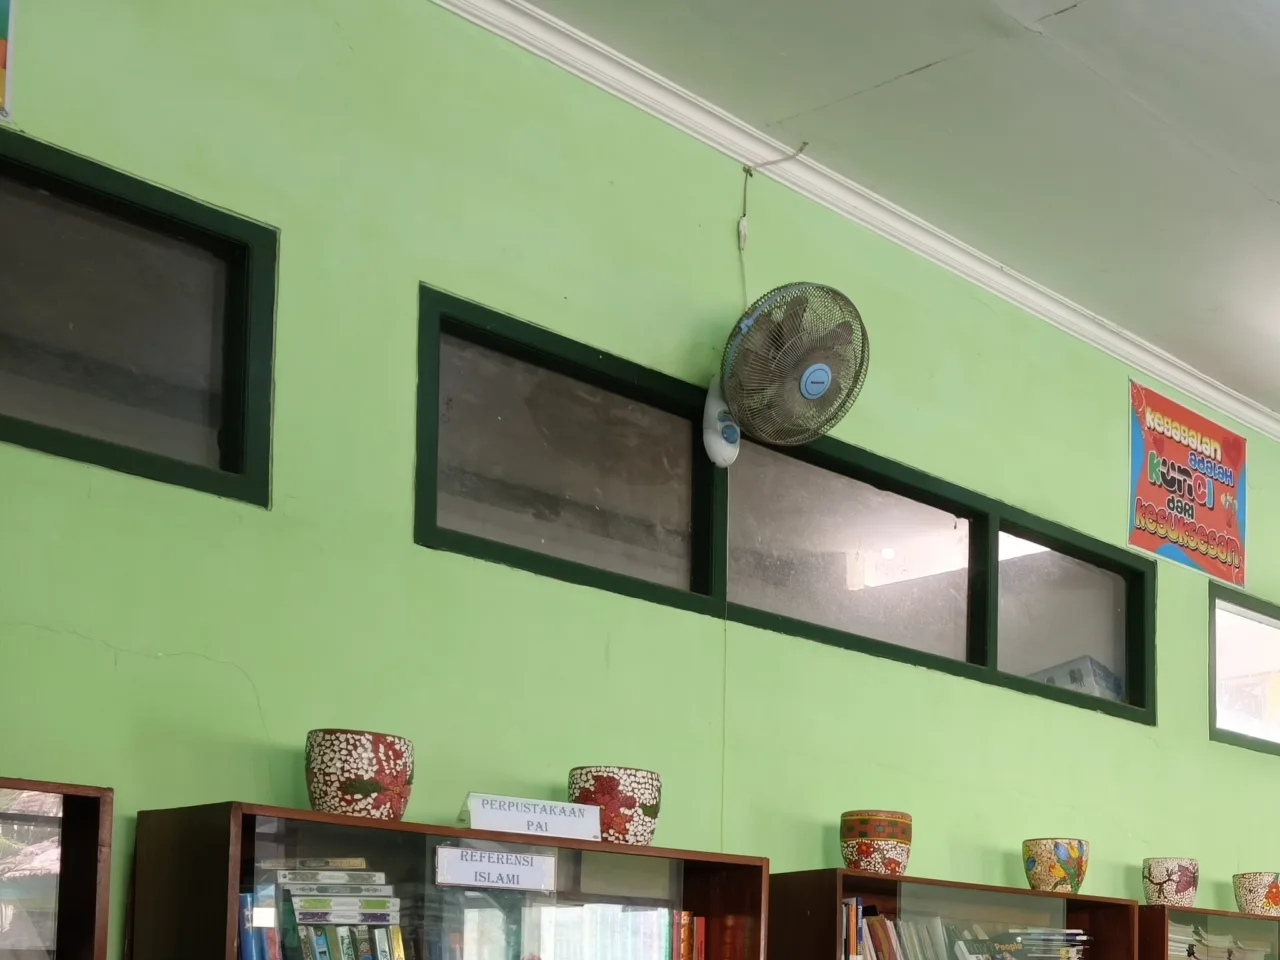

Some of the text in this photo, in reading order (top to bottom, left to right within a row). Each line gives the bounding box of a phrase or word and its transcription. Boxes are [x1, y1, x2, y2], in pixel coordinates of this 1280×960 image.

[481, 799, 585, 818] PERPUSTAKAAN
[526, 821, 548, 832] PAI
[460, 850, 534, 867] REFERENSI
[474, 871, 520, 885] ISLAMI
